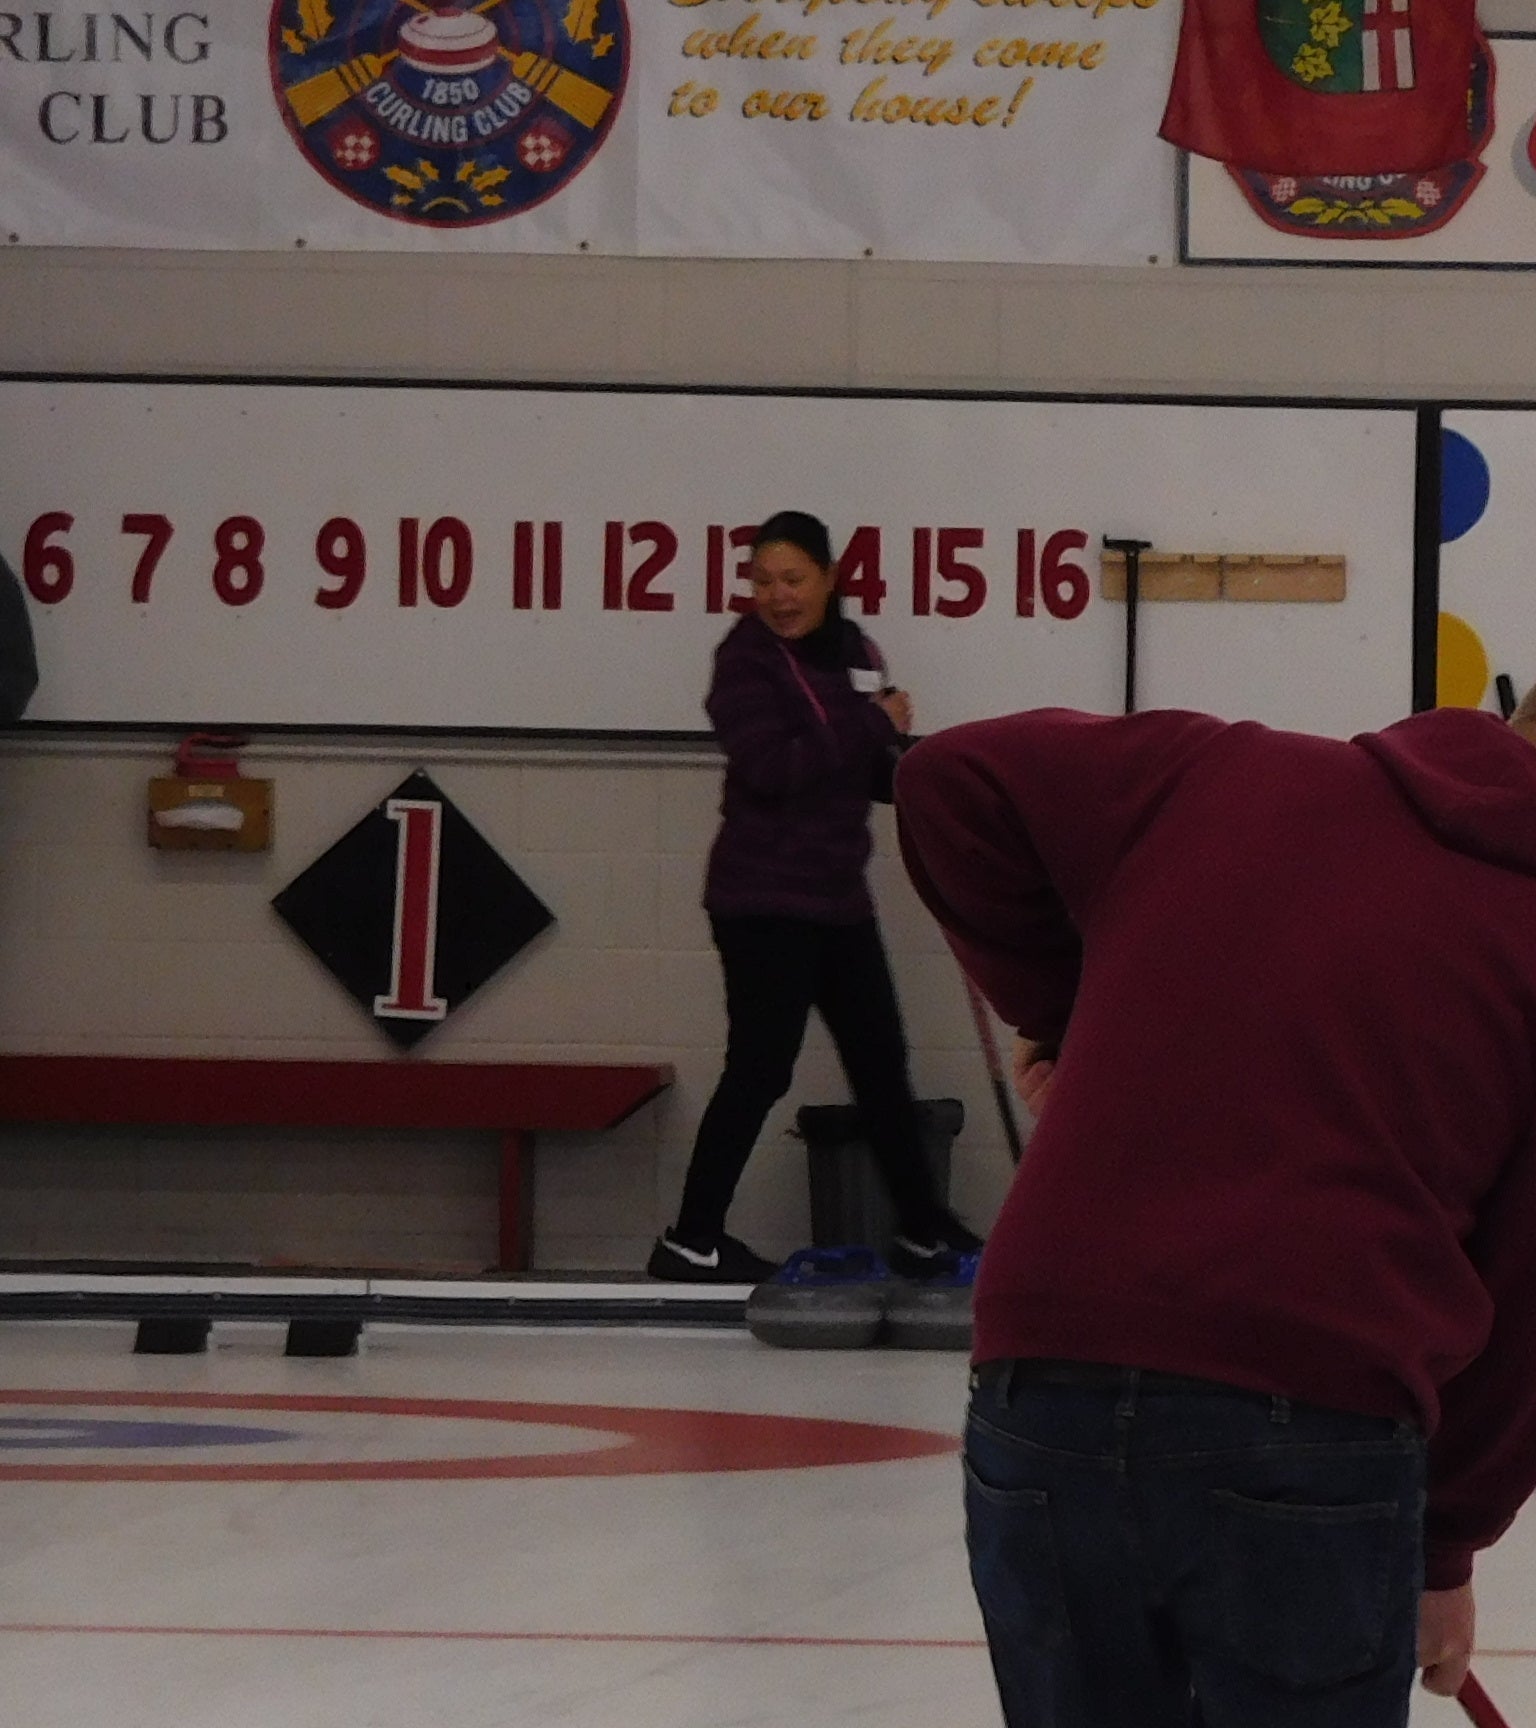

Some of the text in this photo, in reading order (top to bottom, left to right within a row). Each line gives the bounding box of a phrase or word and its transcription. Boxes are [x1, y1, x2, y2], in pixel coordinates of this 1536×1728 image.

[681, 12, 1106, 77] when they come
[36, 90, 228, 145] CLUB
[366, 81, 533, 143] CURLING CLUB
[422, 78, 481, 105] 1850
[666, 74, 1035, 127] to our house!
[23, 511, 75, 604] 6
[122, 513, 174, 604] 7
[212, 515, 266, 606] 8
[314, 517, 367, 609] 9
[398, 516, 473, 608] 10
[512, 521, 563, 611] 11
[603, 521, 678, 612] 12
[913, 527, 988, 618] 15
[1016, 528, 1091, 620] 16
[373, 799, 448, 1020] 1
